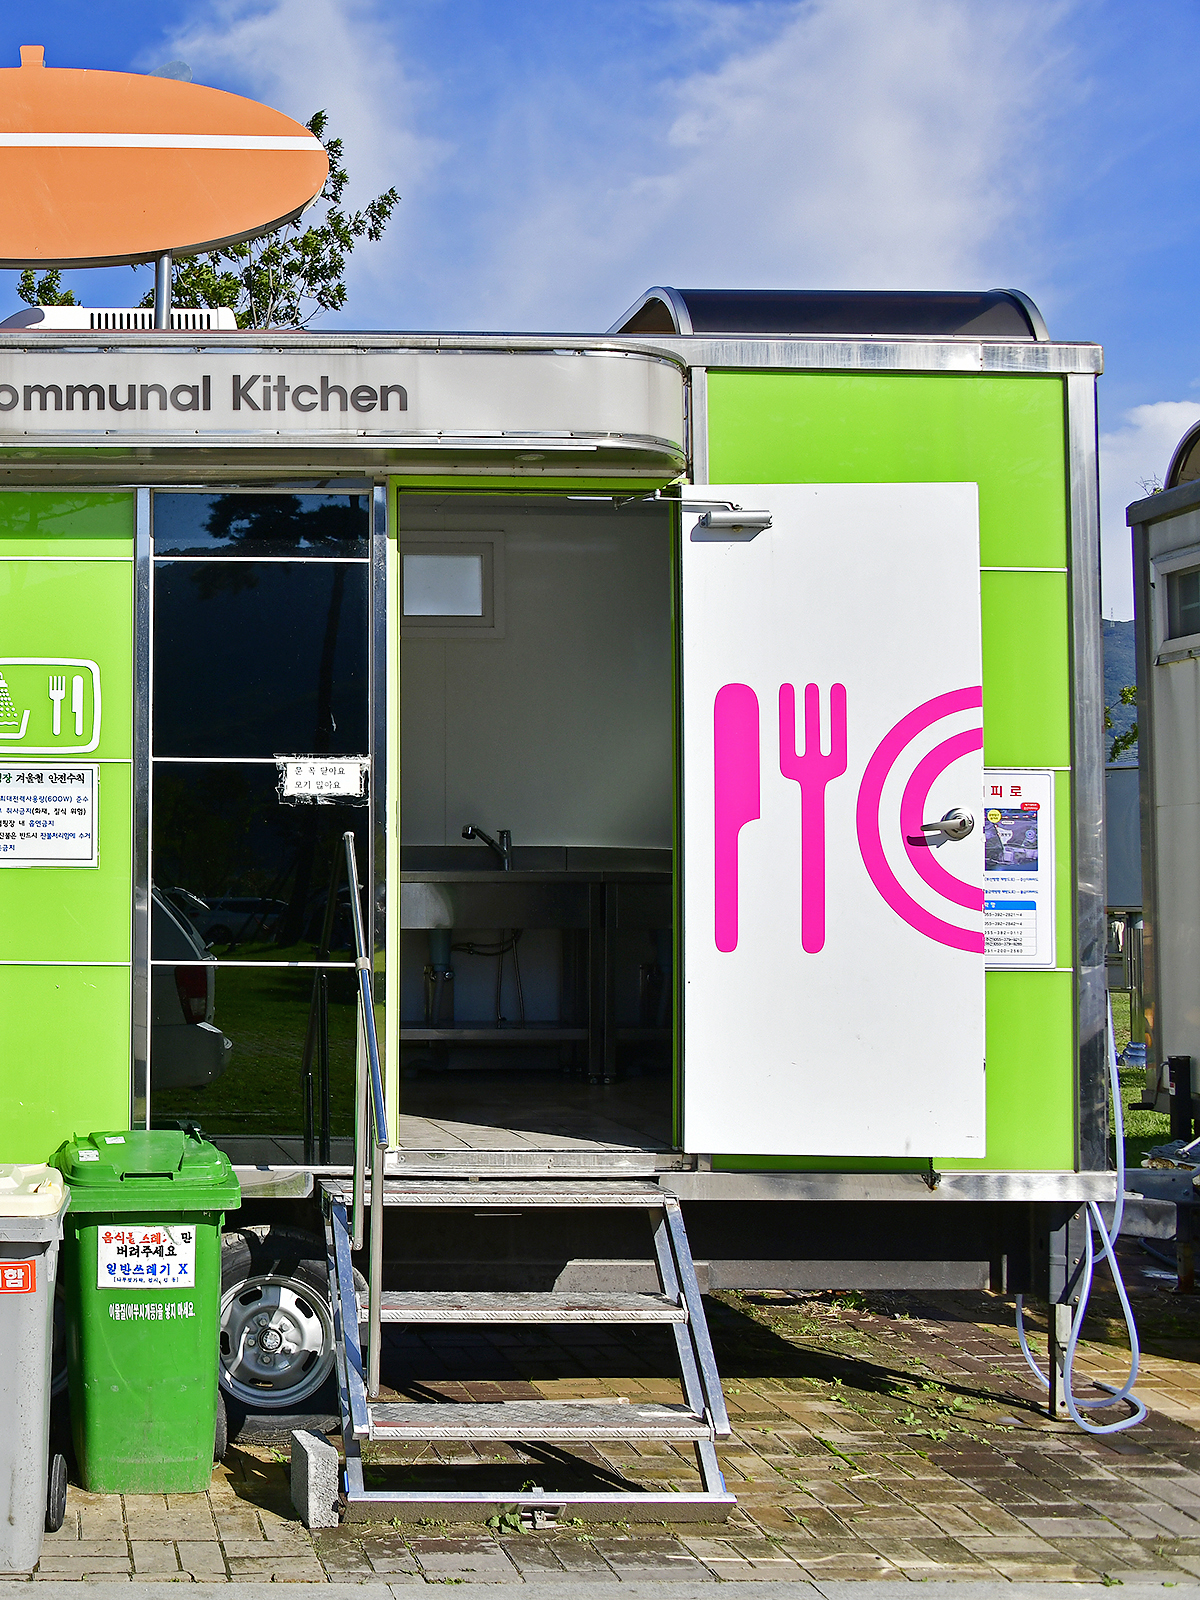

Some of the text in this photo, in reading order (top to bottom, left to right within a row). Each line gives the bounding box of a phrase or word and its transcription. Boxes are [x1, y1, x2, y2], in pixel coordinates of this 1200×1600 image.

[232, 374, 408, 412] Kitchen
[48, 772, 85, 784] 안전수칙
[116, 1244, 178, 1258] 버려주세요
[106, 1262, 188, 1276] 일반쓰레기 X
[164, 1302, 176, 1320] 넣지
